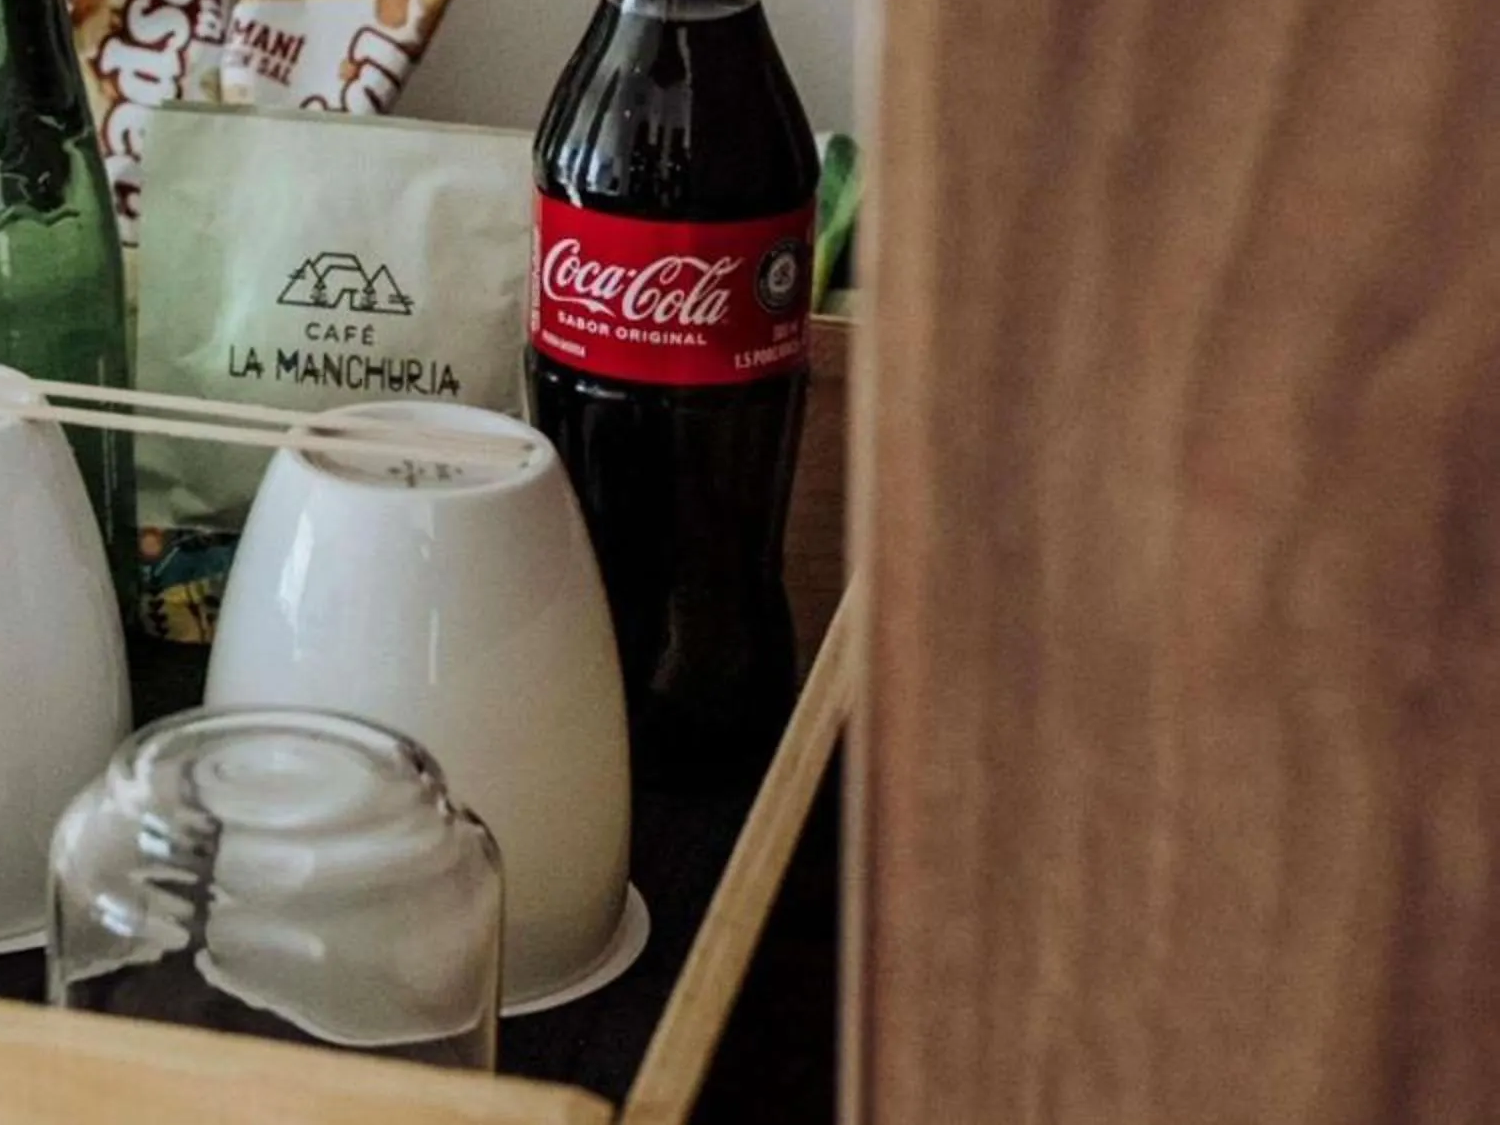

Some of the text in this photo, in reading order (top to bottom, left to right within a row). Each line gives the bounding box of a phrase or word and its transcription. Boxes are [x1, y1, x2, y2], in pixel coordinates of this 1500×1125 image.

[543, 238, 745, 325] Coca-Cola
[305, 323, 375, 345] CAFÉ
[557, 309, 707, 346] SABOR ORIGINAL
[229, 344, 460, 396] LA MANCHURIA
